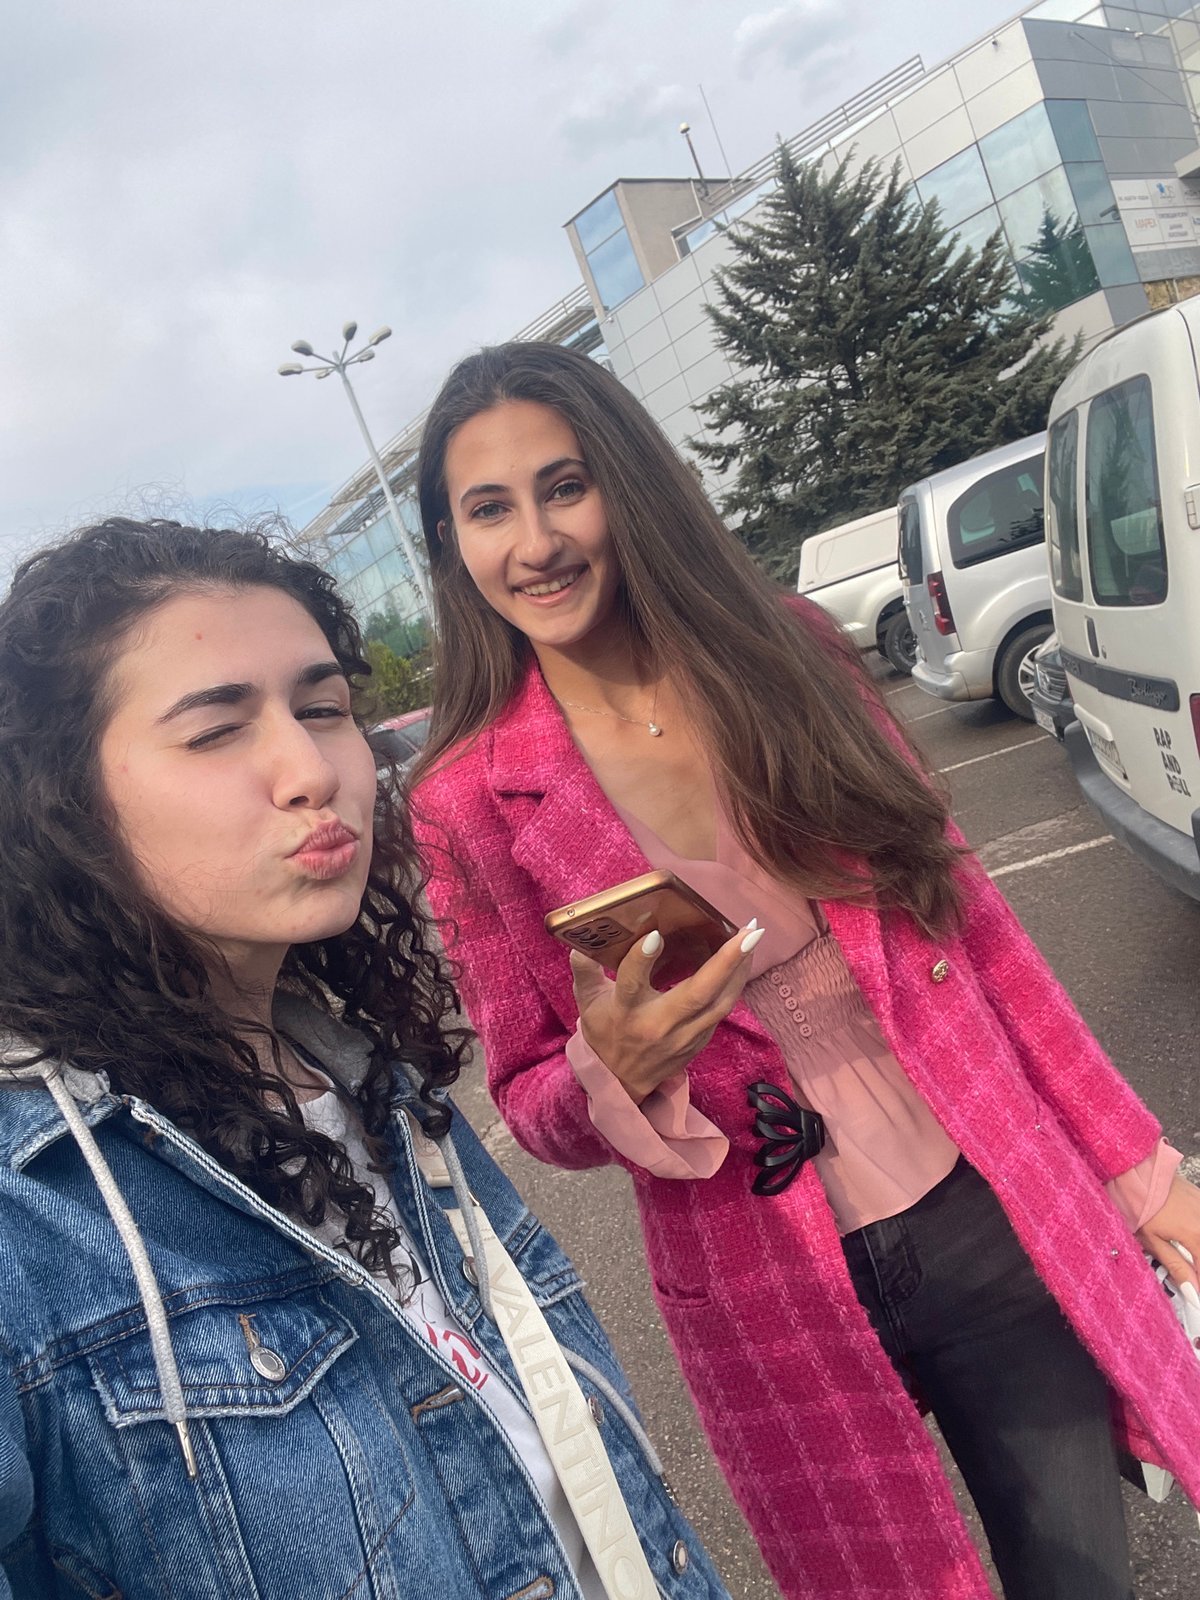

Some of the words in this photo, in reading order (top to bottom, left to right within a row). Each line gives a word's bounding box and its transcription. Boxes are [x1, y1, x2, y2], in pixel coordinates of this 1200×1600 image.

[1128, 678, 1167, 706] Berlingo
[1153, 727, 1172, 750] RAP
[1161, 751, 1181, 775] AND
[1166, 773, 1192, 797] ROLL
[488, 1263, 643, 1600] VALENTINO
